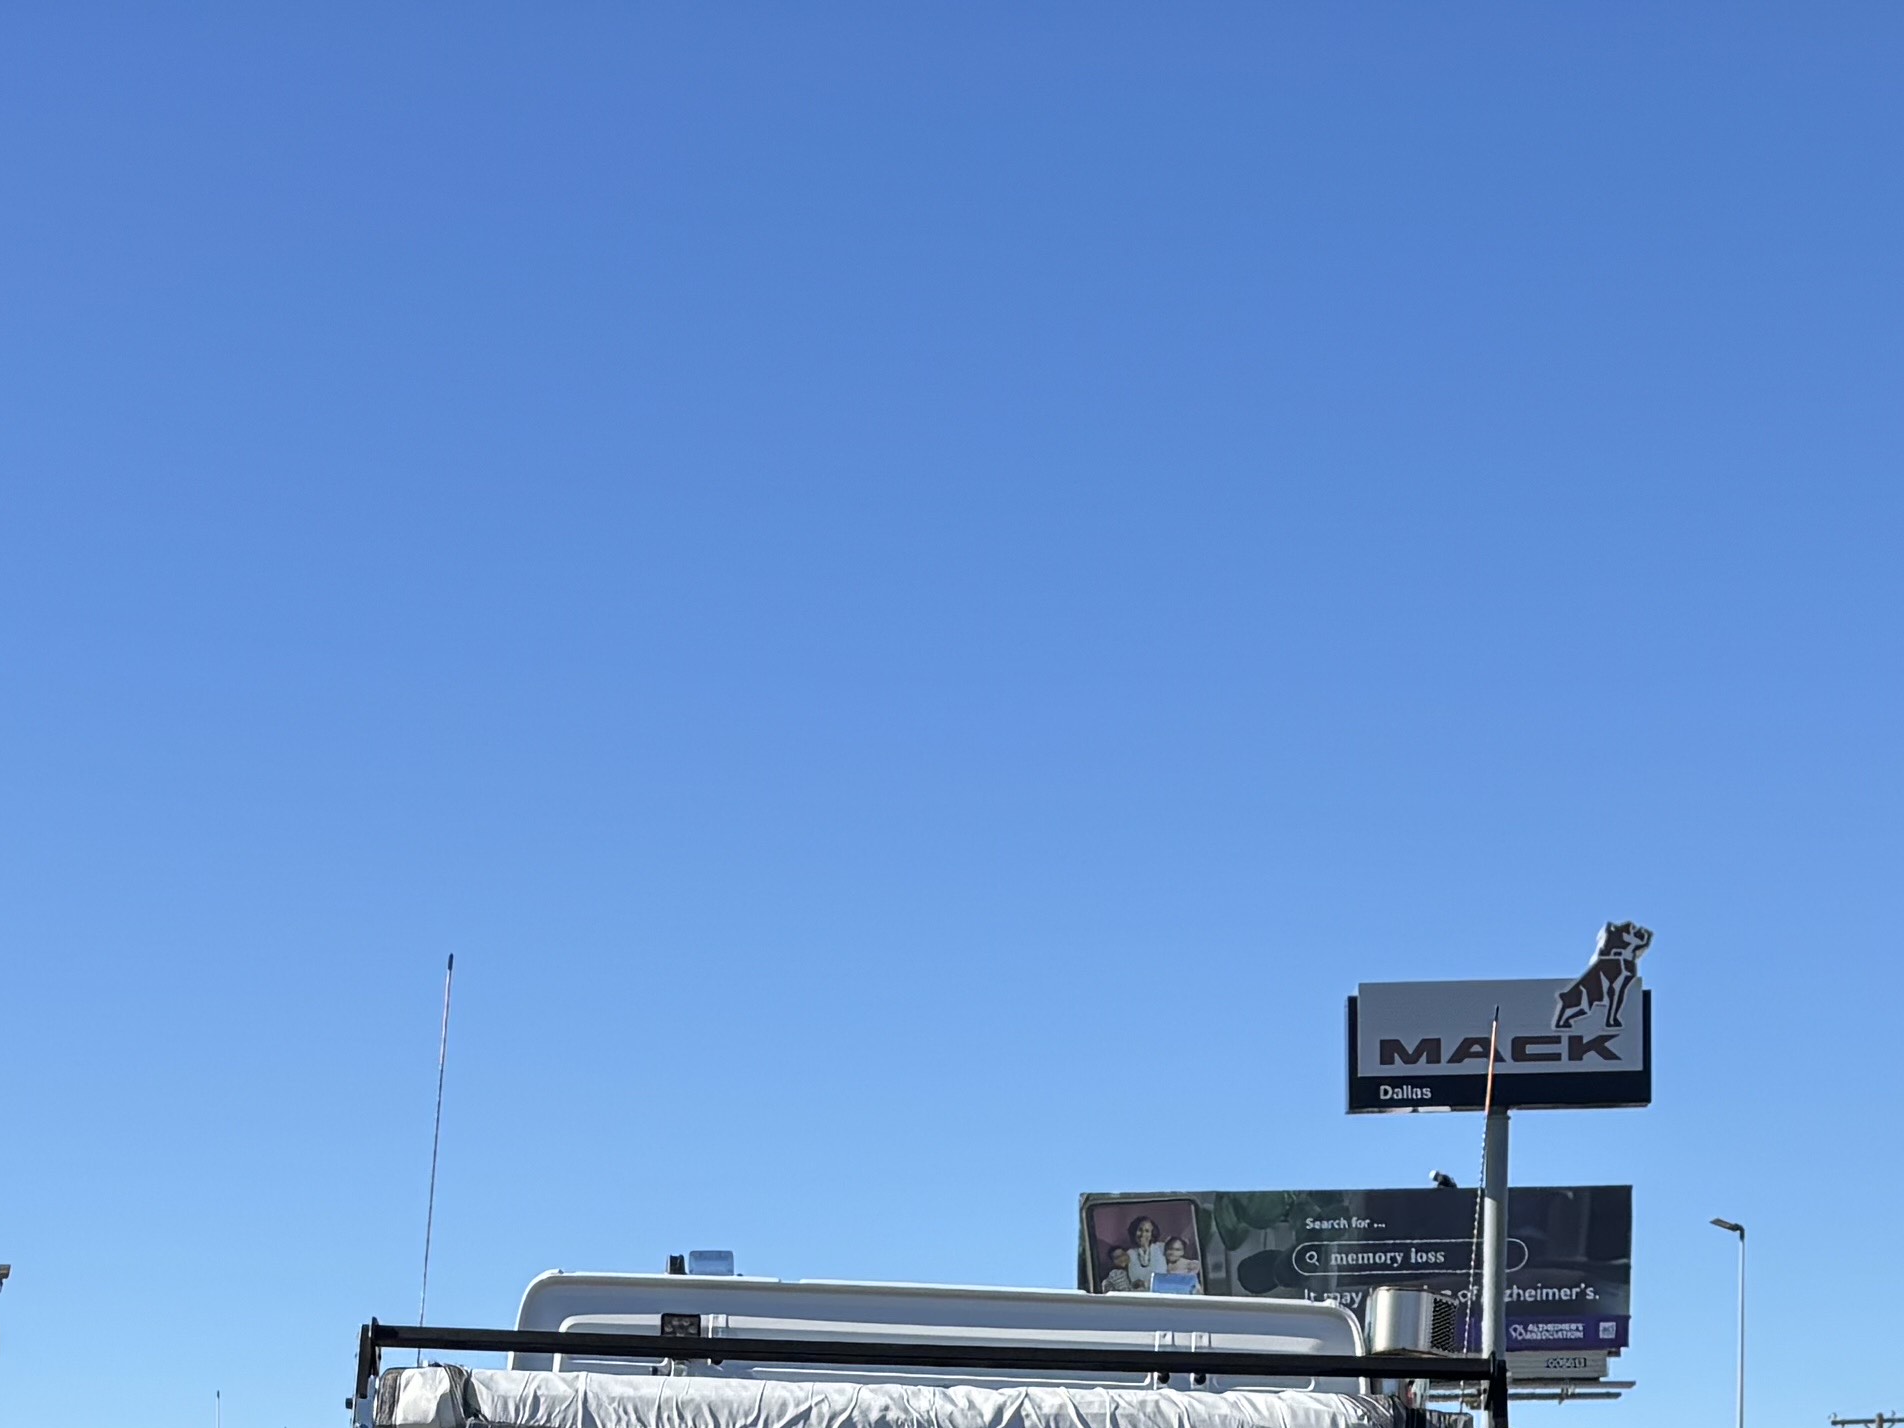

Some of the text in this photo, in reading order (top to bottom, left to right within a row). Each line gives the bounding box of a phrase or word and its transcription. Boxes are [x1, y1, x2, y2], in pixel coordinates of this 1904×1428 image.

[1379, 1034, 1623, 1066] MACK
[1379, 1084, 1432, 1100] Dallas
[1305, 1217, 1348, 1230] Search
[1351, 1216, 1371, 1228] for
[1330, 1247, 1445, 1267] memory loss
[1504, 1283, 1600, 1302] zheimer's.
